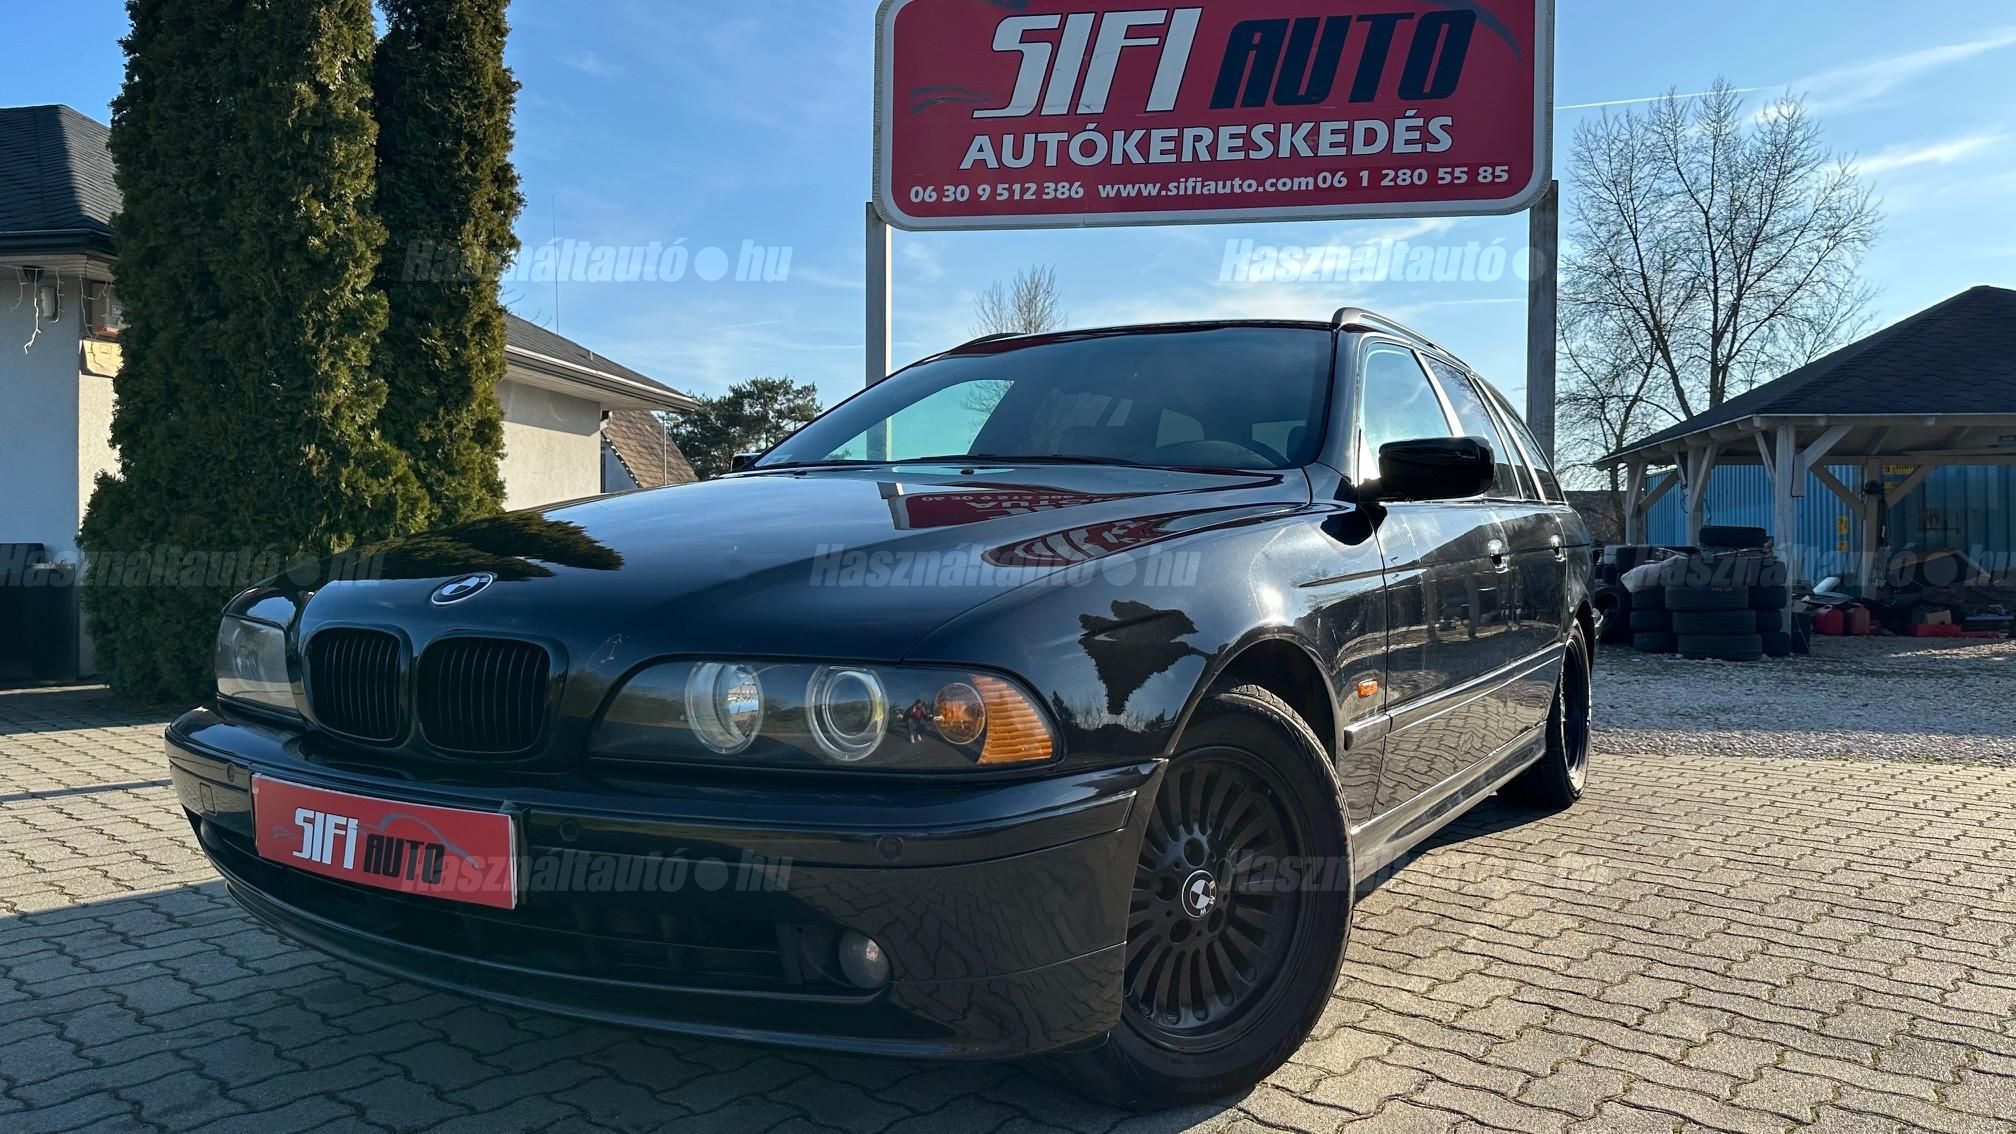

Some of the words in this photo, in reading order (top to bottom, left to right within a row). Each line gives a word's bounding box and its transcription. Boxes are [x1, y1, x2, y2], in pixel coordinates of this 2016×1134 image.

[972, 7, 1202, 118] SIFI
[1209, 9, 1476, 110] AUTO
[958, 109, 1454, 171] AUTÓKERESKEDÉS
[909, 186, 937, 203] 06
[942, 185, 970, 202] 30
[976, 185, 991, 201] 9
[996, 183, 1037, 201] 512
[1042, 182, 1084, 199] 386
[1098, 174, 1314, 199] www.sifiauto.com
[1317, 171, 1348, 189] 06
[1359, 170, 1370, 187] 1
[1380, 168, 1428, 187] 280
[1437, 166, 1468, 185] 55
[1477, 165, 1509, 183] 85
[292, 806, 359, 871] SIFI
[362, 833, 445, 884] AUTO
